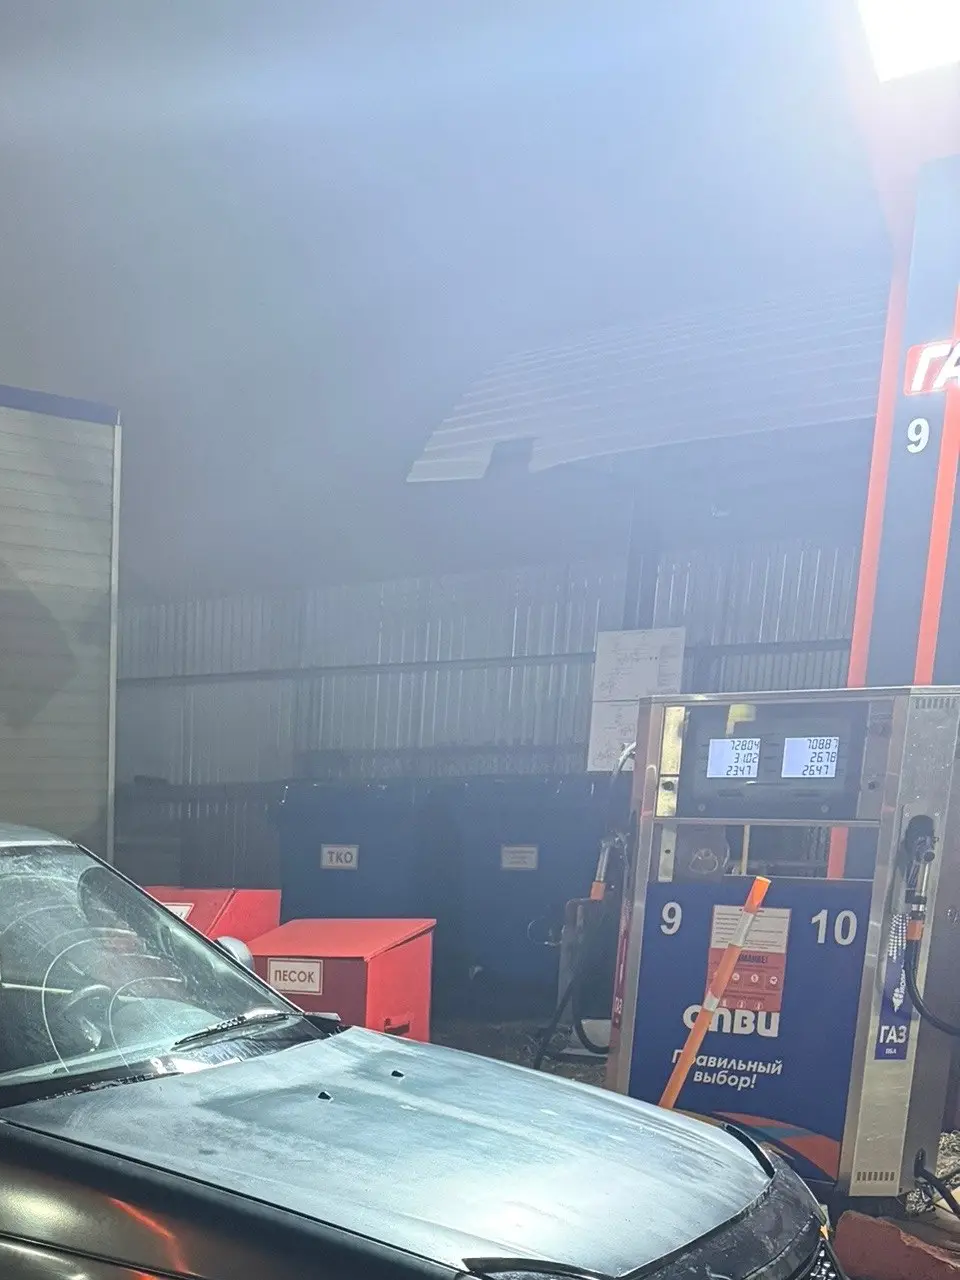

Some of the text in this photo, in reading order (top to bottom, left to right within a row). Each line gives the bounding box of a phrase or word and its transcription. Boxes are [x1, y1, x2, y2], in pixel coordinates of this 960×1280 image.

[906, 417, 930, 454] 9
[327, 850, 354, 865] ТКО
[660, 901, 683, 935] 9
[811, 909, 858, 946] 10
[274, 969, 315, 983] ПЕСОК
[879, 1025, 907, 1044] ГАЗ
[693, 1070, 757, 1091] выбор!
